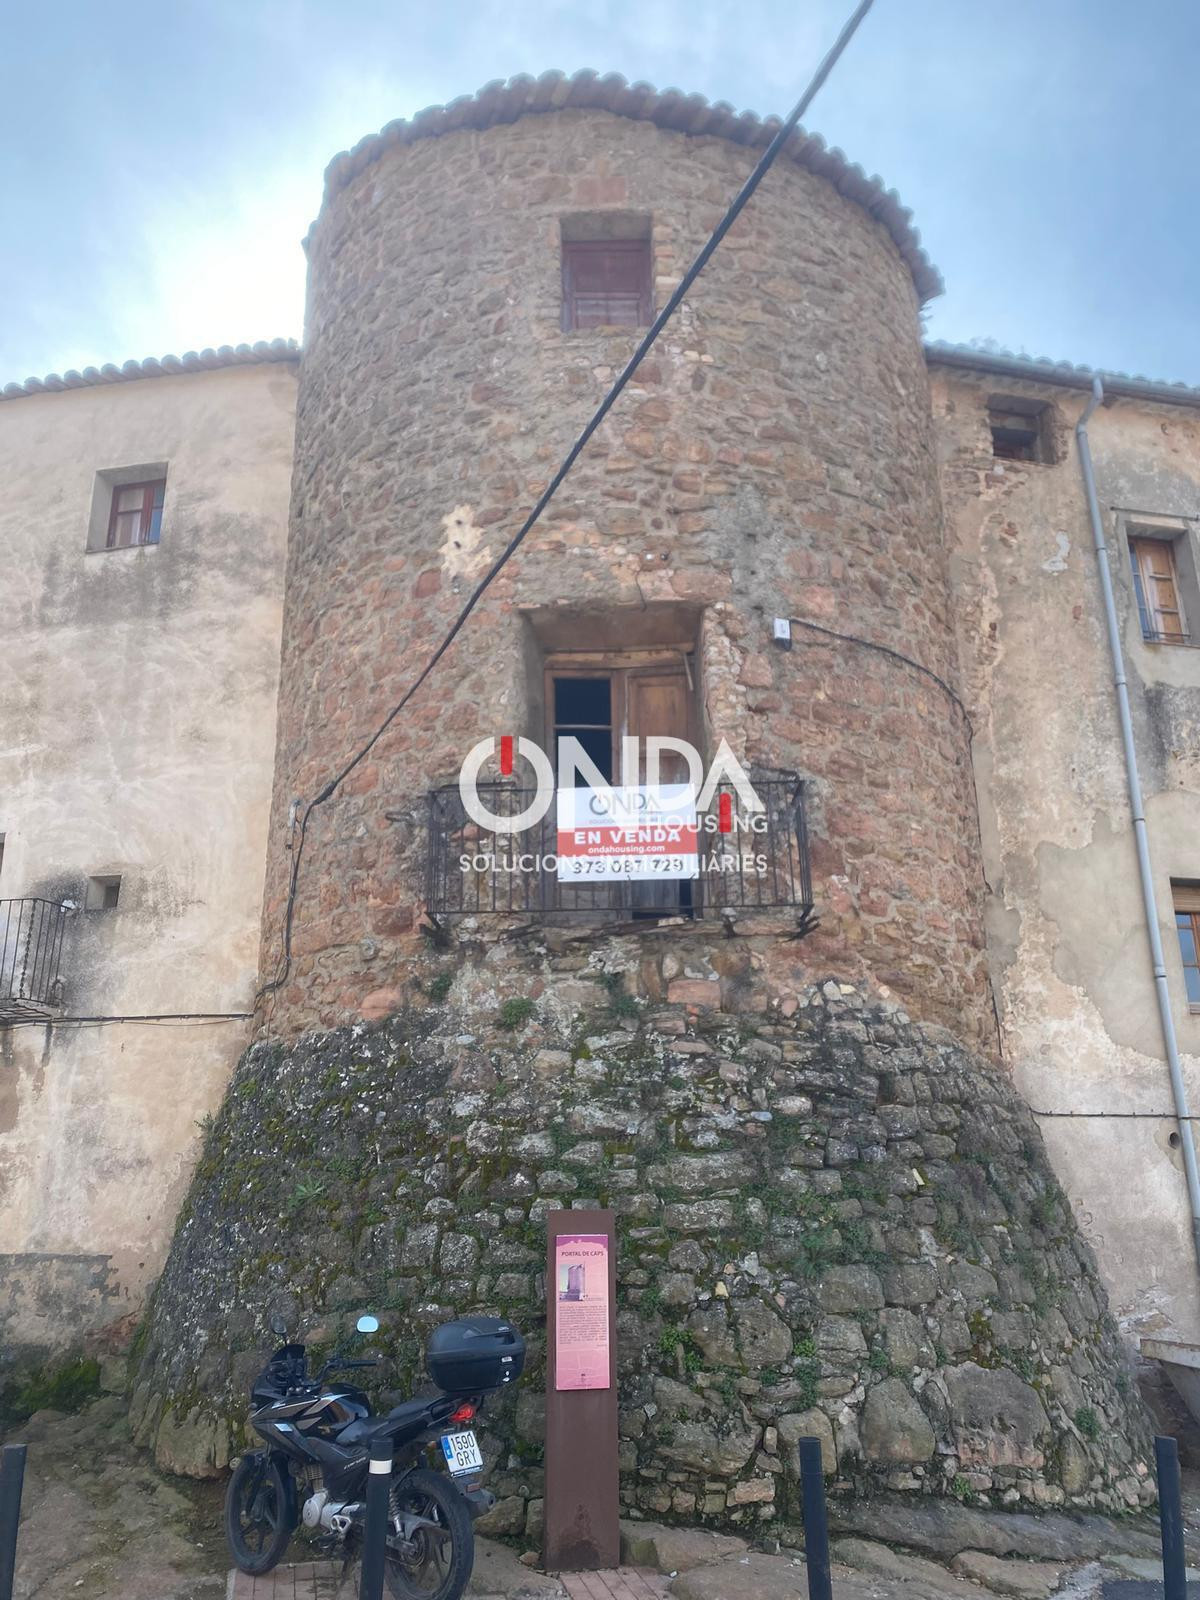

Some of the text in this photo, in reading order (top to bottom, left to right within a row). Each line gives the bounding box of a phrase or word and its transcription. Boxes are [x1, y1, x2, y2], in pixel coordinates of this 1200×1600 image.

[589, 793, 660, 816] ONDA
[574, 829, 681, 845] EN VENDA
[588, 844, 665, 854] ondahousing.com
[573, 861, 606, 875] 373
[450, 1432, 475, 1451] 1590
[456, 1449, 477, 1466] GRY
